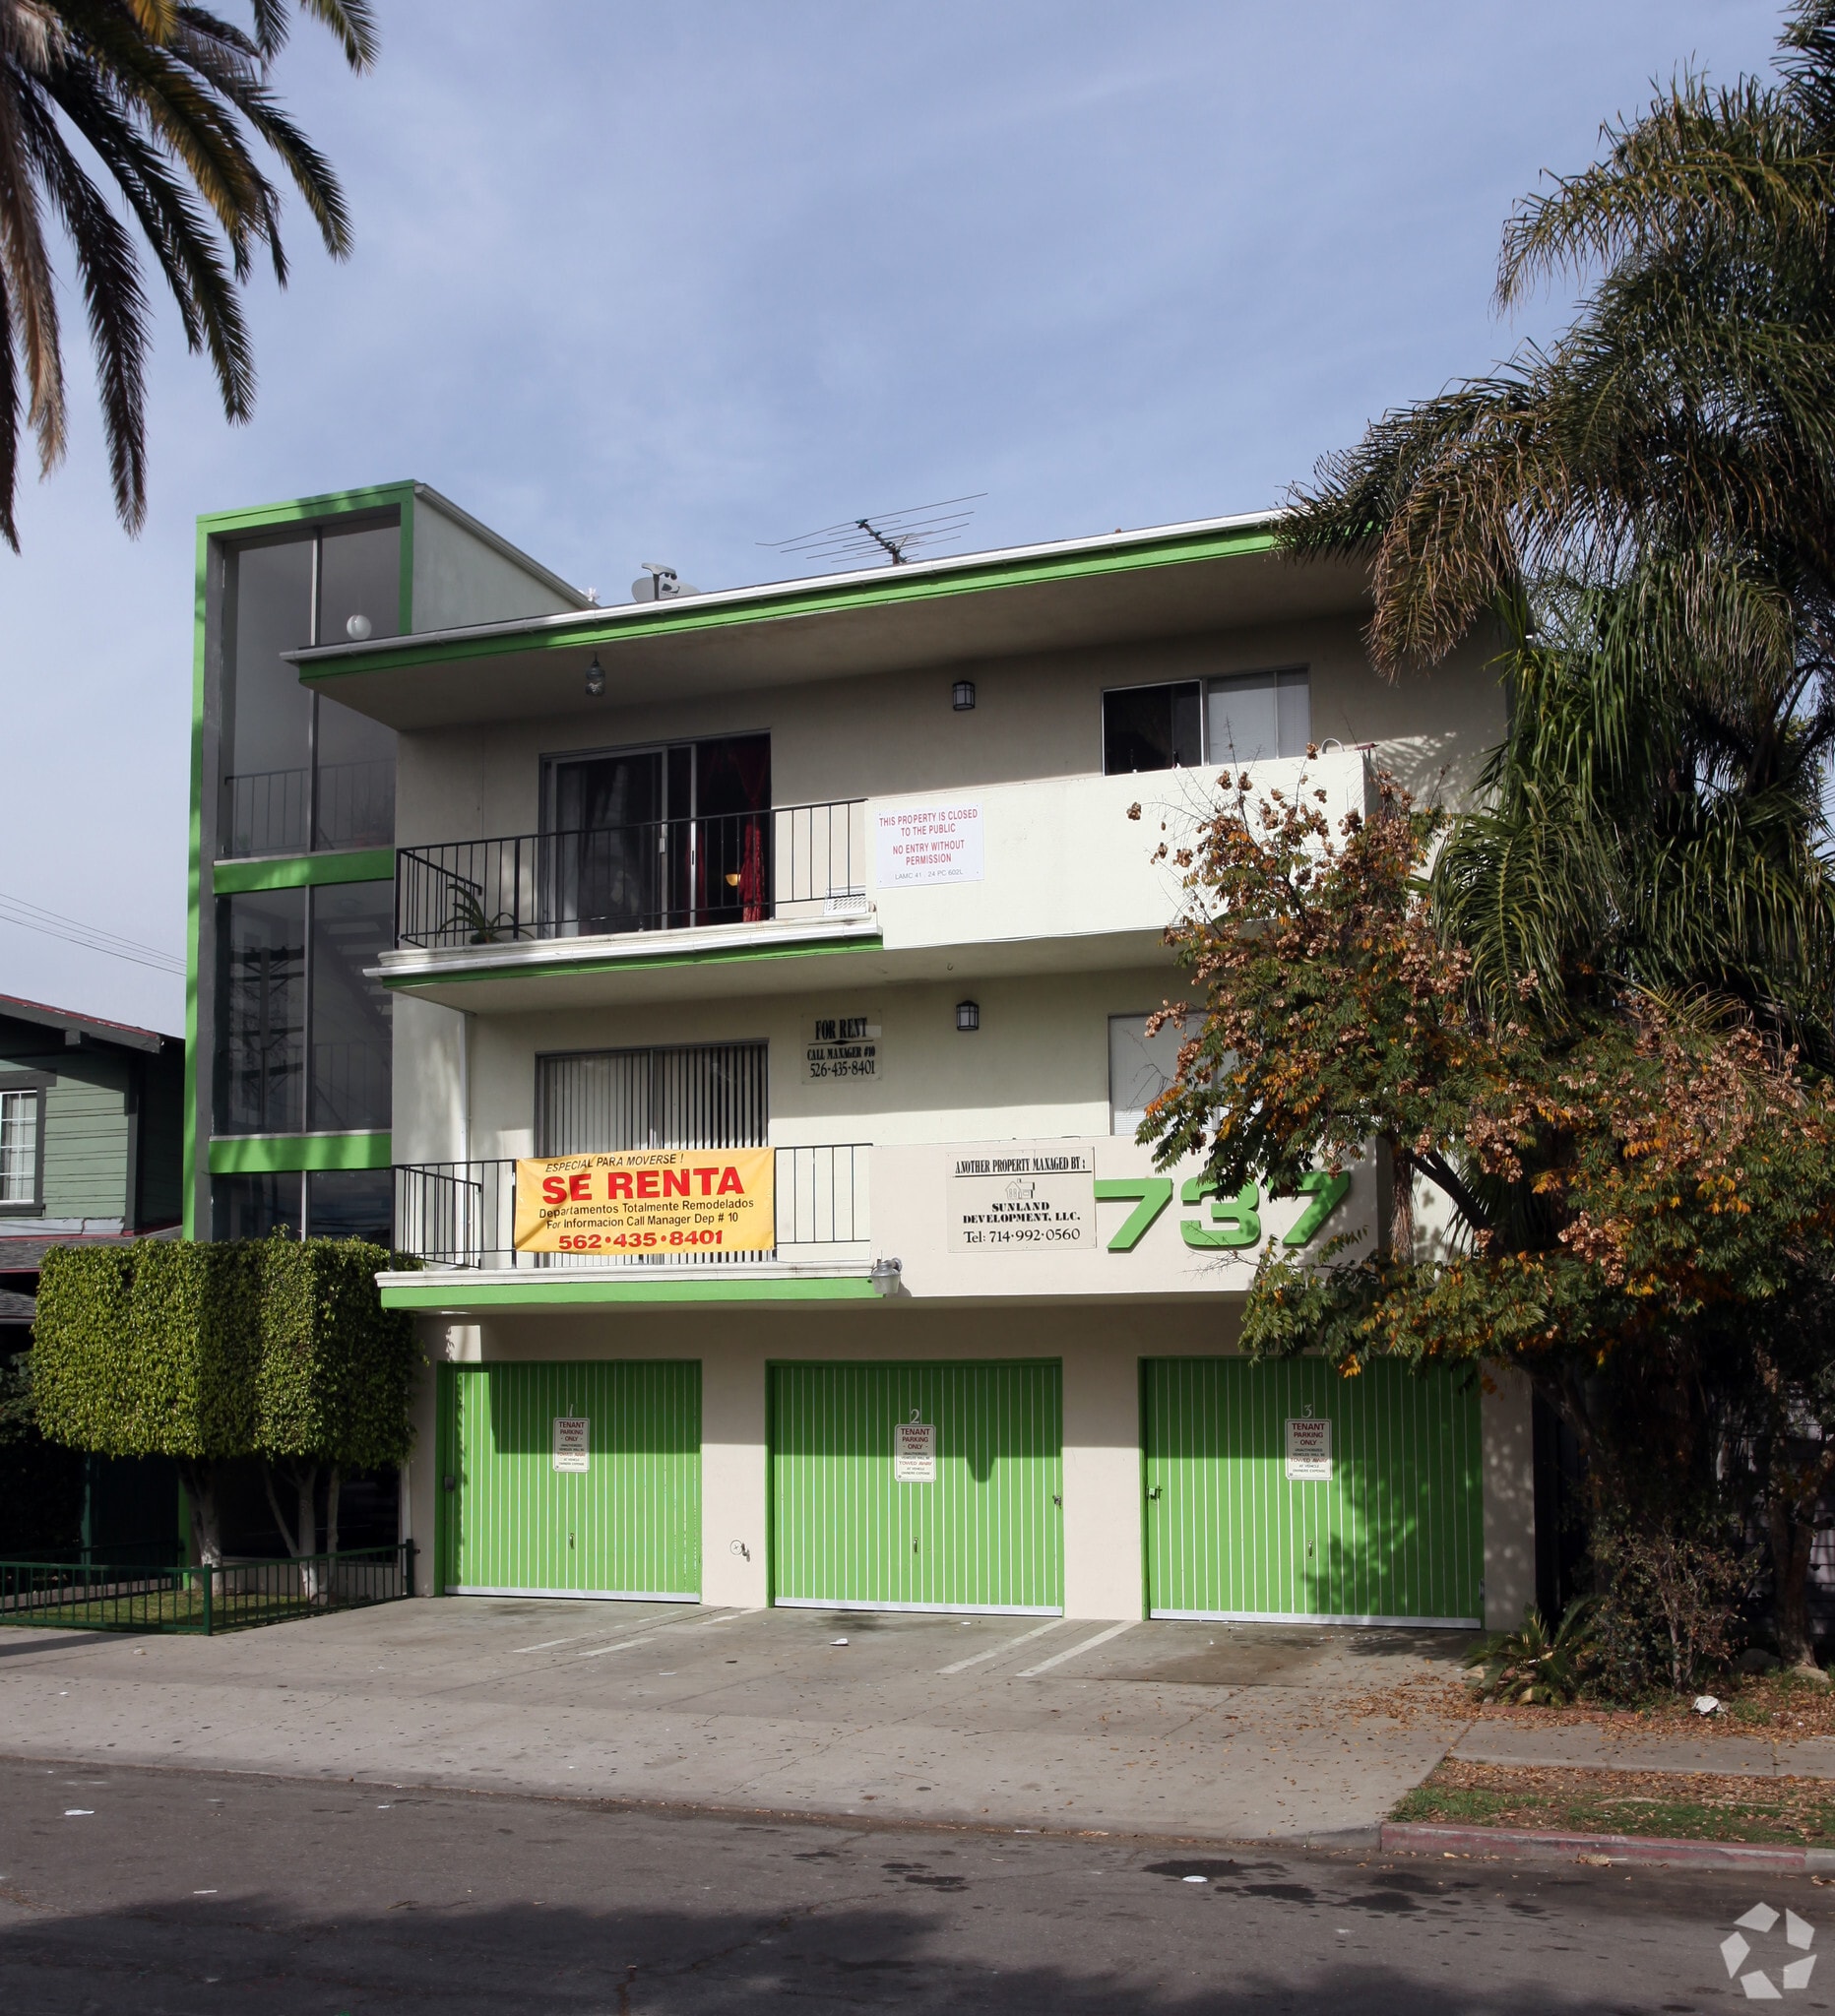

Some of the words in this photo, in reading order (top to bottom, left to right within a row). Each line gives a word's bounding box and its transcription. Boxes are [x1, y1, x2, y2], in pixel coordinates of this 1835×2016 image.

[879, 815, 896, 827] THIS
[898, 812, 937, 825] PROPERTY
[938, 811, 946, 821] IS
[948, 808, 978, 820] CLOSED
[901, 827, 911, 837] TO
[913, 826, 926, 836] THE
[928, 823, 956, 834] PUBLIC
[892, 845, 904, 854] NO
[906, 843, 929, 853] ENTRY
[930, 840, 965, 851] WITHOUT
[906, 853, 952, 866] PERMISSION
[815, 1019, 836, 1040] FOR
[839, 1017, 867, 1039] RENT
[807, 1048, 825, 1060] CALL
[827, 1046, 861, 1059] MANAGER
[545, 1159, 594, 1173] ESPECIAL
[596, 1157, 623, 1167] PARA
[626, 1154, 676, 1166] MOVERSE
[955, 1160, 990, 1173] ANOTHER
[992, 1158, 1030, 1172] PROPERTY
[1033, 1157, 1069, 1171] MANAGED
[1070, 1156, 1081, 1169] BY
[541, 1172, 593, 1205] SE
[607, 1166, 745, 1200] RENTA
[538, 1202, 619, 1219] Departamentos
[622, 1202, 679, 1213] Totalmente
[682, 1198, 754, 1211] Remodelados
[991, 1201, 1049, 1212] SUNLAND
[1094, 1170, 1351, 1249] 737
[546, 1220, 562, 1229] For
[563, 1217, 624, 1228] Informacion
[626, 1215, 645, 1227] Call
[647, 1215, 691, 1228] Manager
[694, 1214, 715, 1226] Dep
[728, 1212, 738, 1223] 10
[963, 1212, 1051, 1224] DEVELOPMENT,
[1055, 1211, 1081, 1222] LLC.
[963, 1230, 985, 1243] Tel:
[910, 1408, 920, 1424] 2
[1301, 1403, 1312, 1418] 3
[1292, 1422, 1325, 1431] TENANT
